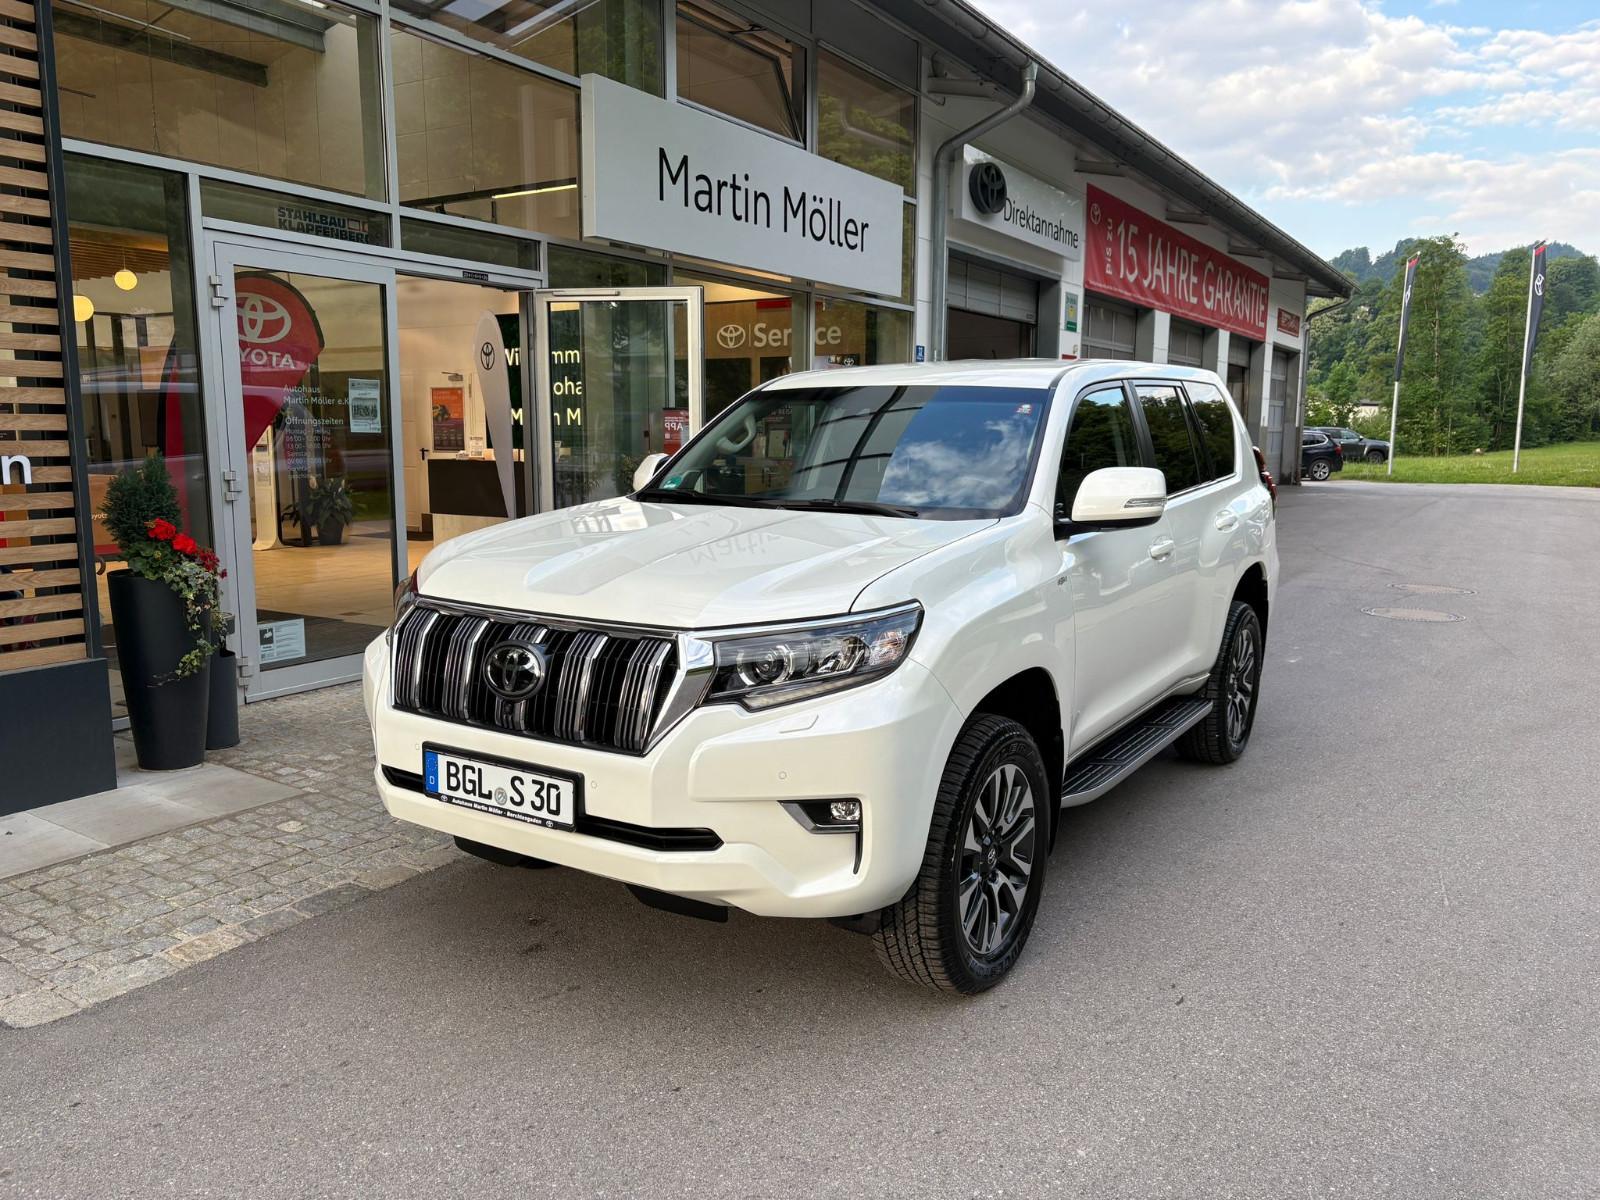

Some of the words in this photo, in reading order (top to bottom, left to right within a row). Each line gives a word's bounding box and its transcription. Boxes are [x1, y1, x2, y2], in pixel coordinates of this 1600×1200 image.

[658, 147, 771, 228] Martin
[784, 186, 869, 252] Möller
[277, 206, 346, 229] STAHLBAU
[1004, 197, 1079, 249] Direktannahme
[1117, 219, 1139, 283] 15
[1143, 233, 1199, 305] JAHRE
[1202, 260, 1267, 329] GARANTIE
[753, 322, 842, 348] Serce
[240, 347, 296, 369] YOTA
[283, 384, 321, 394] Autohaus
[283, 396, 309, 406] Martin
[285, 415, 344, 427] Öffnungszeiten
[429, 775, 435, 785] D
[446, 760, 493, 800] BGL
[509, 775, 525, 807] S
[530, 779, 561, 816] 30
[473, 802, 488, 812] Martin
[488, 806, 504, 815] Möller
